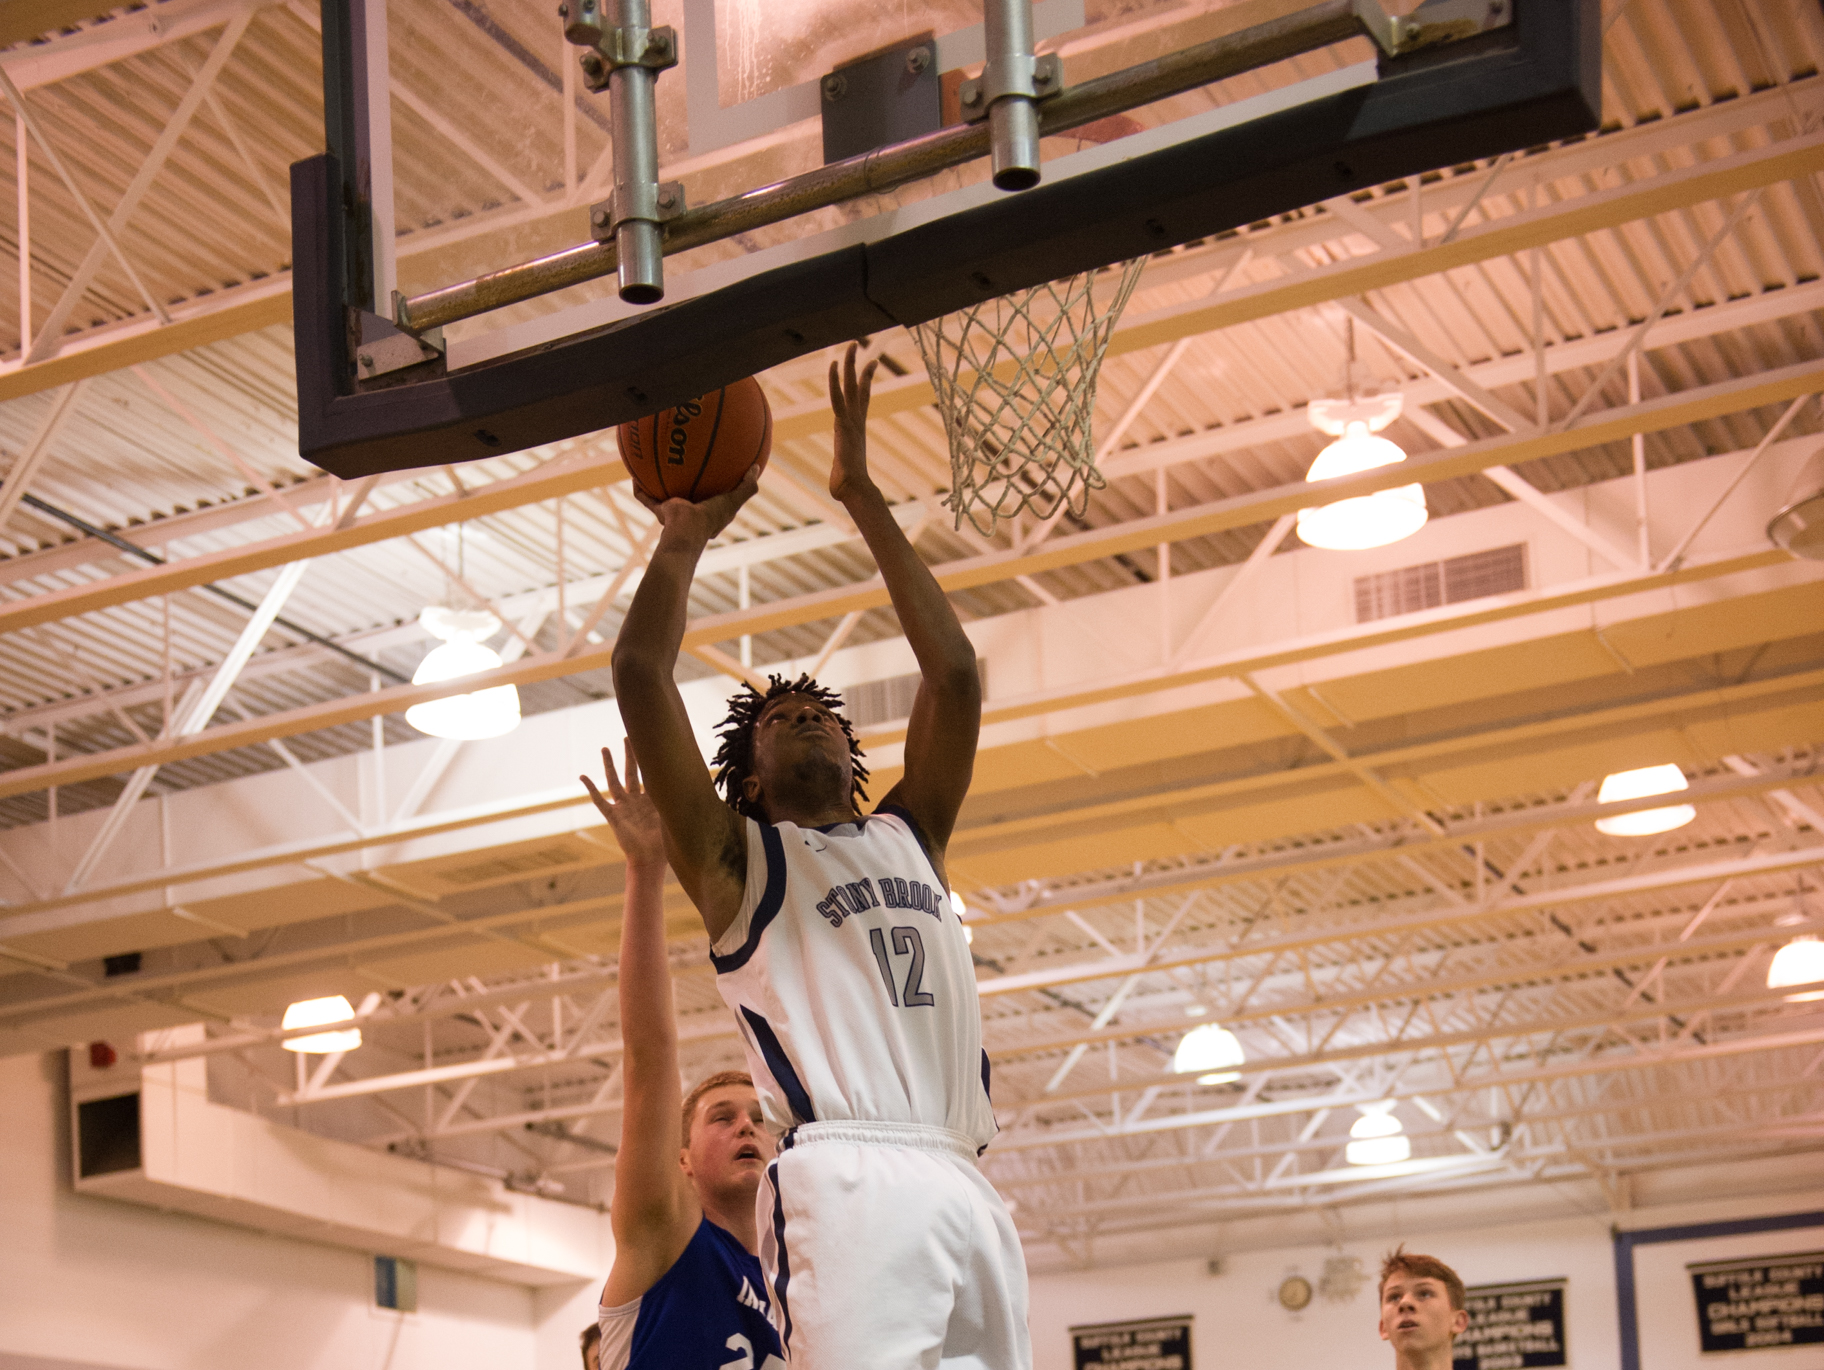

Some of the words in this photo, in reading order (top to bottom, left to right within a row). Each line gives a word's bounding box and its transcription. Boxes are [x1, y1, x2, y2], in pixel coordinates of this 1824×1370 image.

[816, 876, 880, 928] STONY
[878, 876, 942, 922] BROOK
[869, 926, 935, 1007] 12
